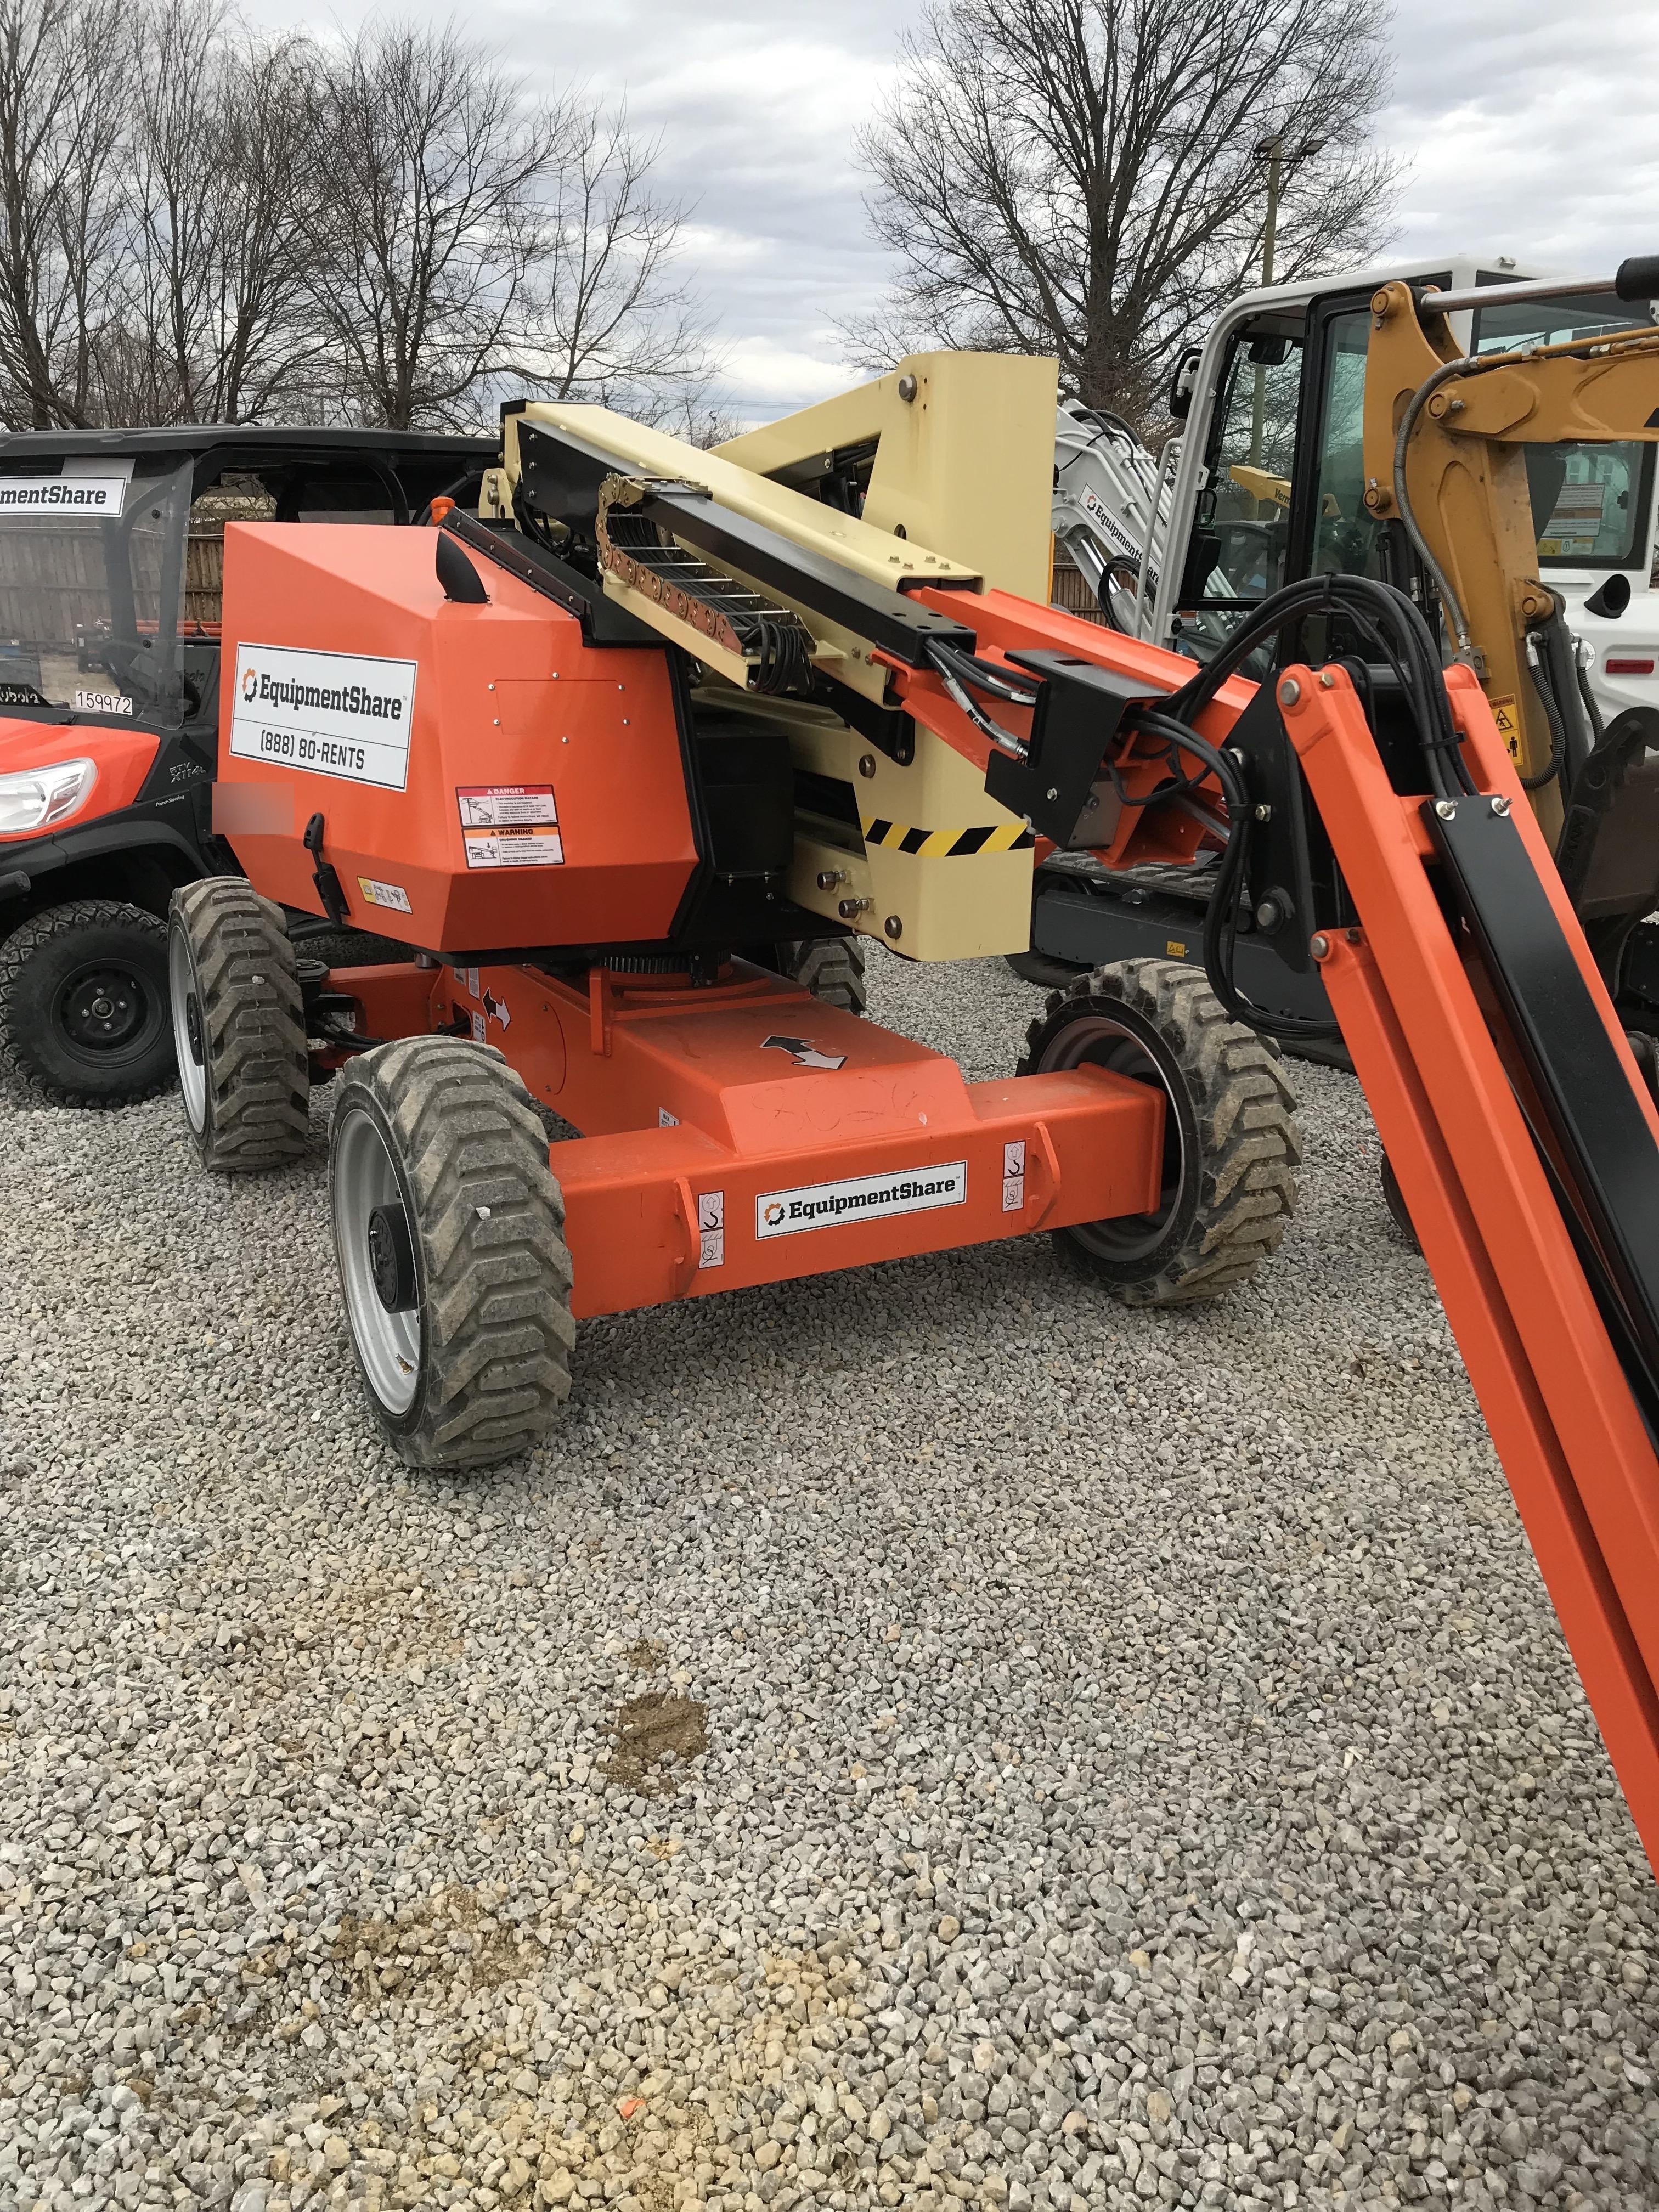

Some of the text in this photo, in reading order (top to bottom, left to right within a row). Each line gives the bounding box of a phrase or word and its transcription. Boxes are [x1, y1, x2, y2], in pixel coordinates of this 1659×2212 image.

[77, 691, 131, 714] 159972
[259, 673, 402, 720] EquipmentShare
[260, 730, 365, 770] (888) 80-RENTS
[789, 1178, 956, 1220] EquipmentShare
